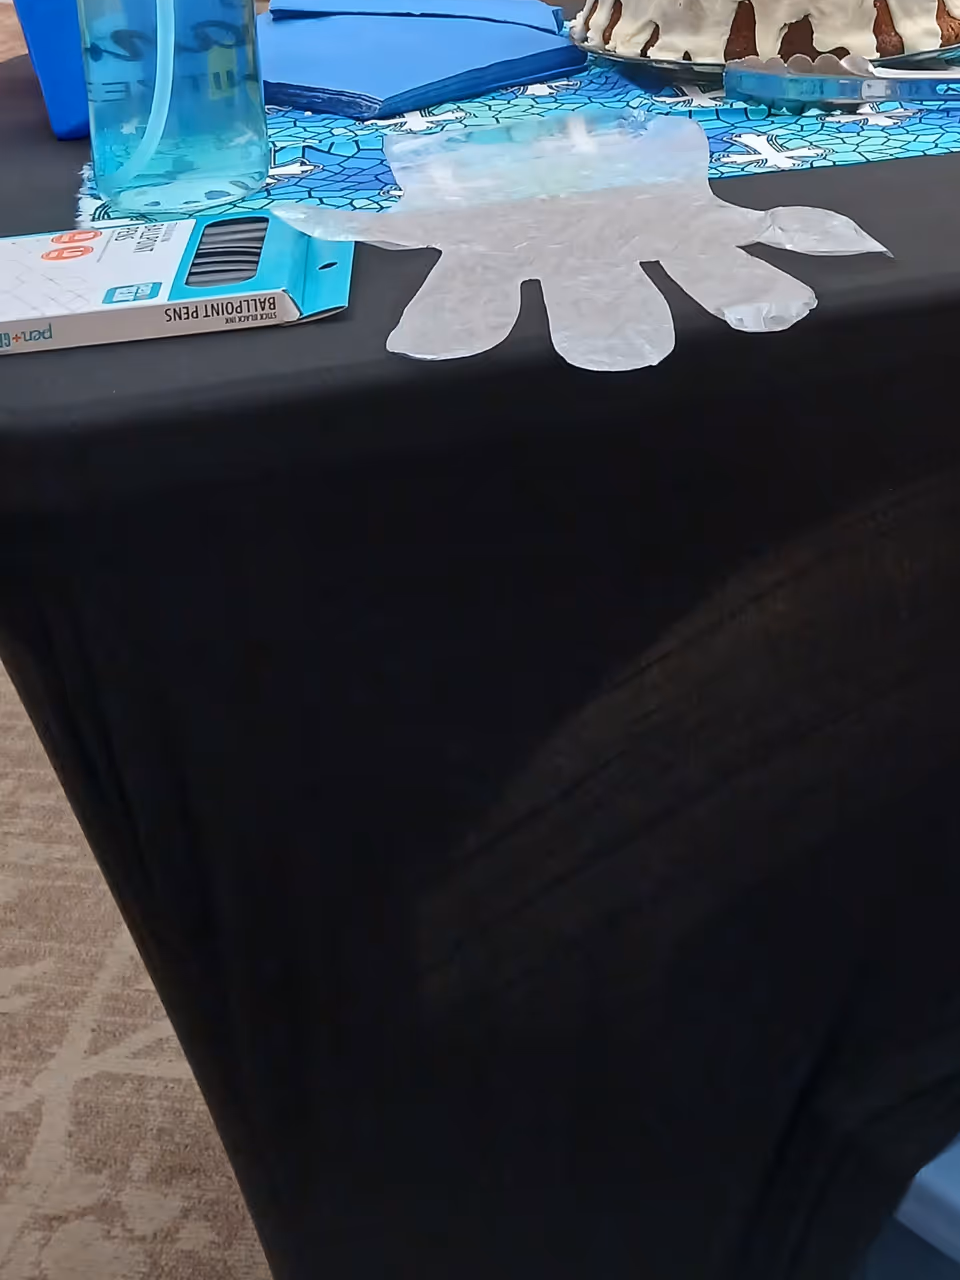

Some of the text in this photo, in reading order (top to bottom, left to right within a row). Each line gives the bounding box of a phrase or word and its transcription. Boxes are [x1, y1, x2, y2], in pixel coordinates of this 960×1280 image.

[164, 296, 277, 322] BALLPOINT PENS
[259, 311, 277, 321] STICK
